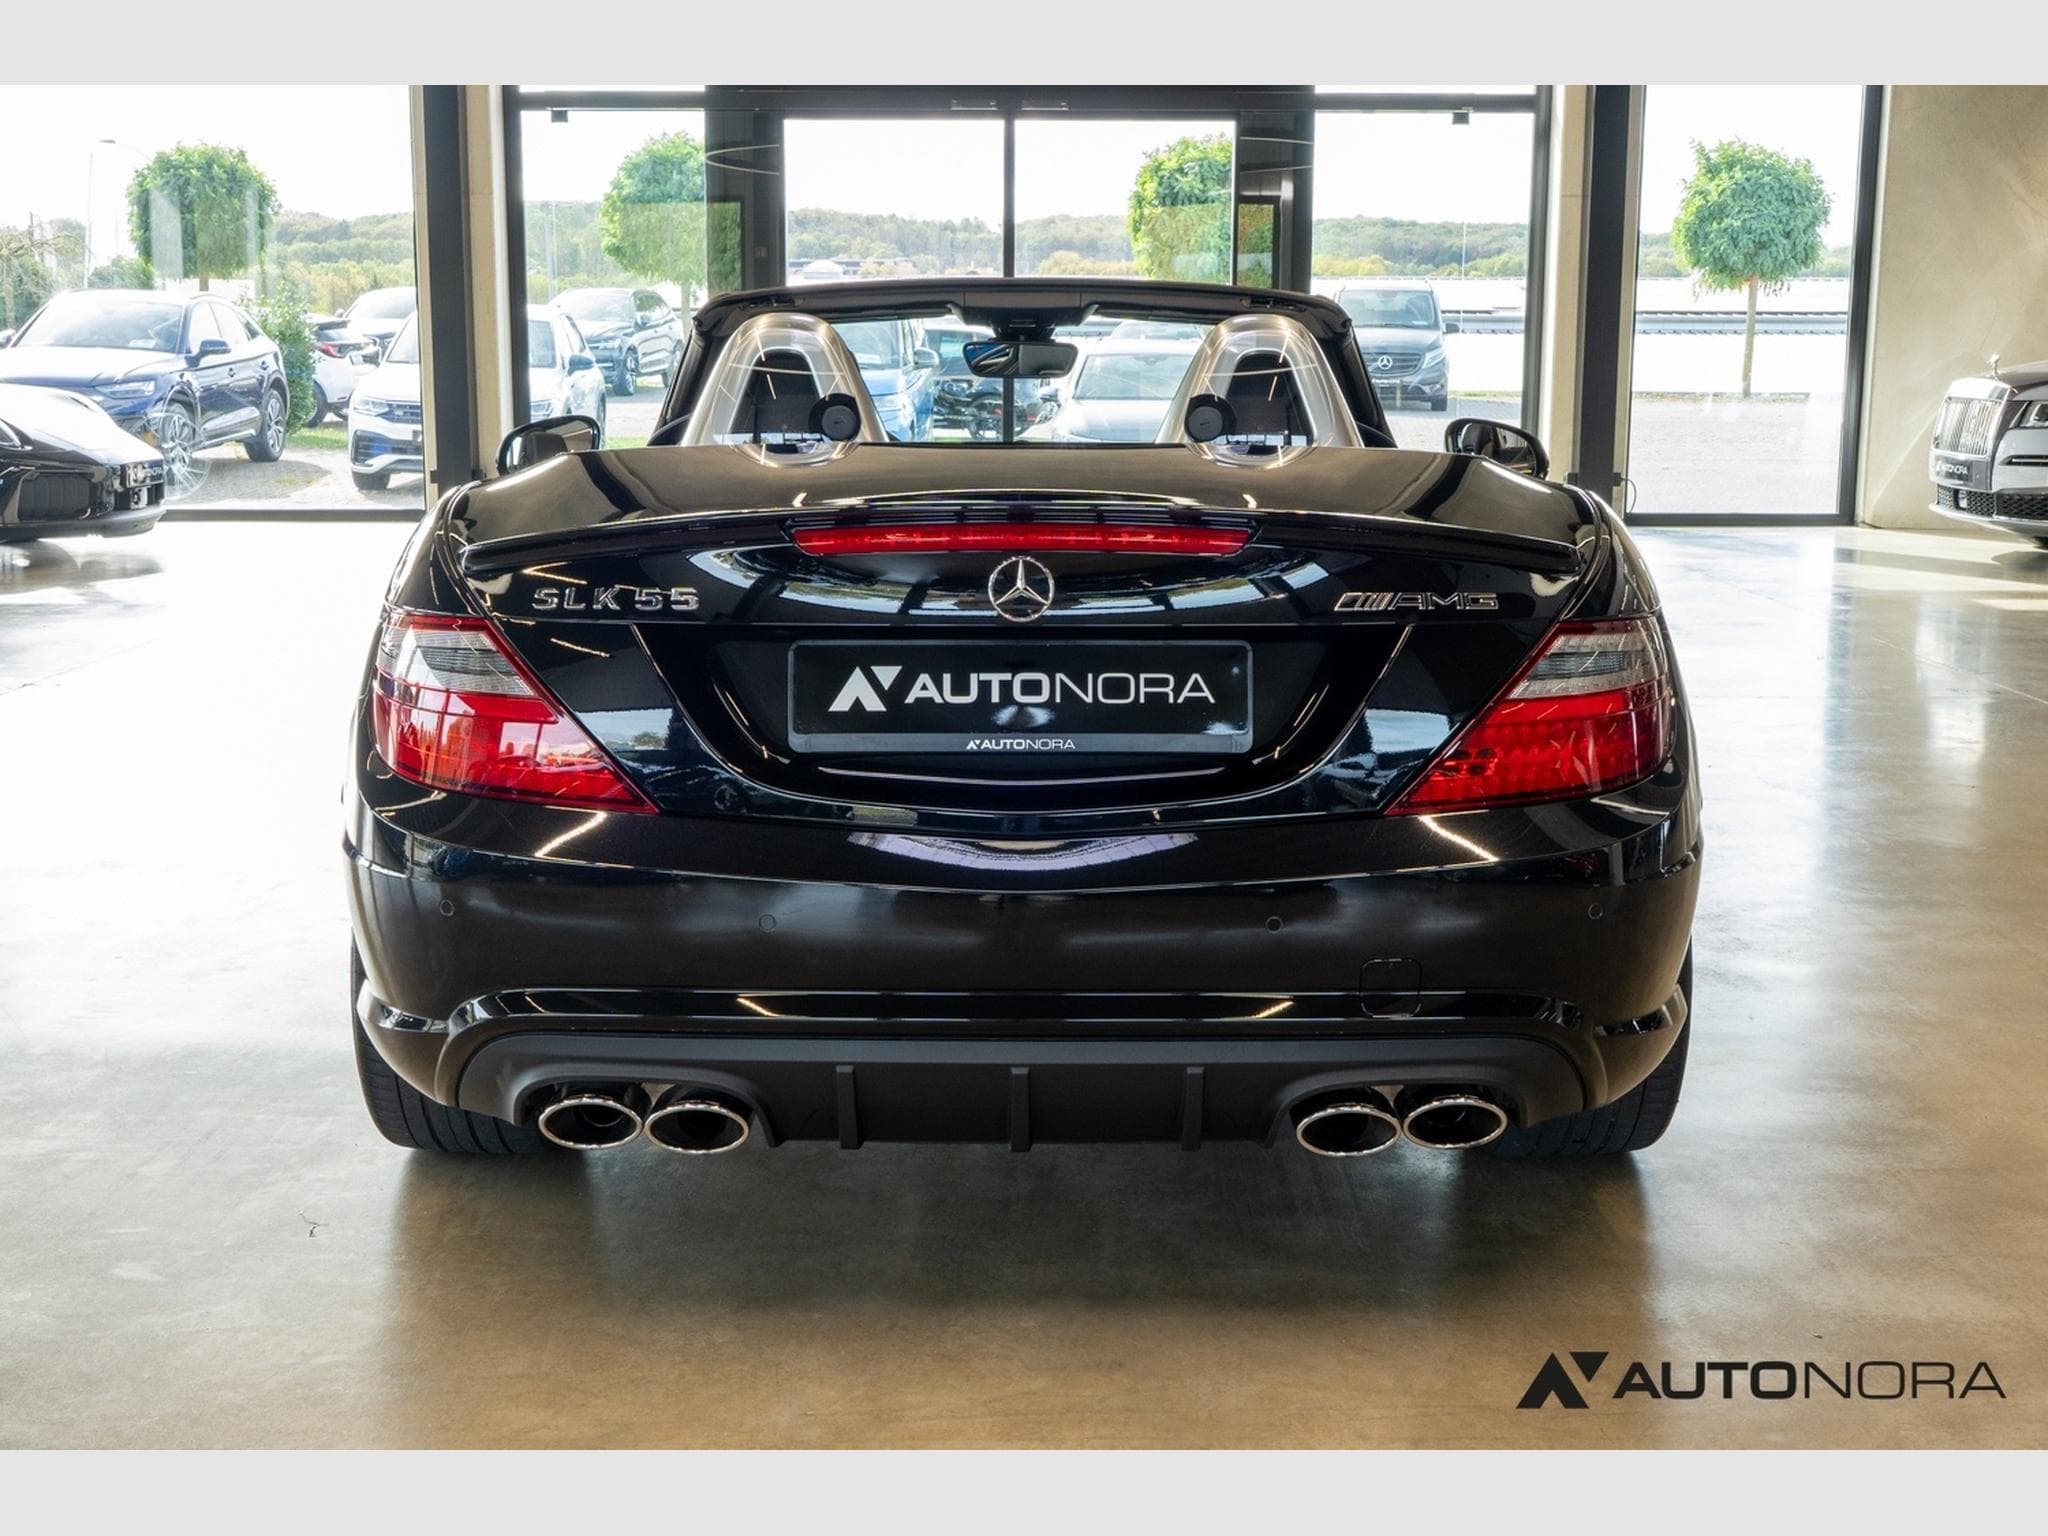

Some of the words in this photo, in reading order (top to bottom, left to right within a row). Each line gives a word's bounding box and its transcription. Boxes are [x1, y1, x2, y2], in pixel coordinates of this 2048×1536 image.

[531, 586, 621, 611] SLK
[634, 586, 700, 612] 55
[1387, 591, 1499, 611] AMG
[904, 672, 1216, 705] AUTONORA
[980, 738, 1076, 750] AUTONORA
